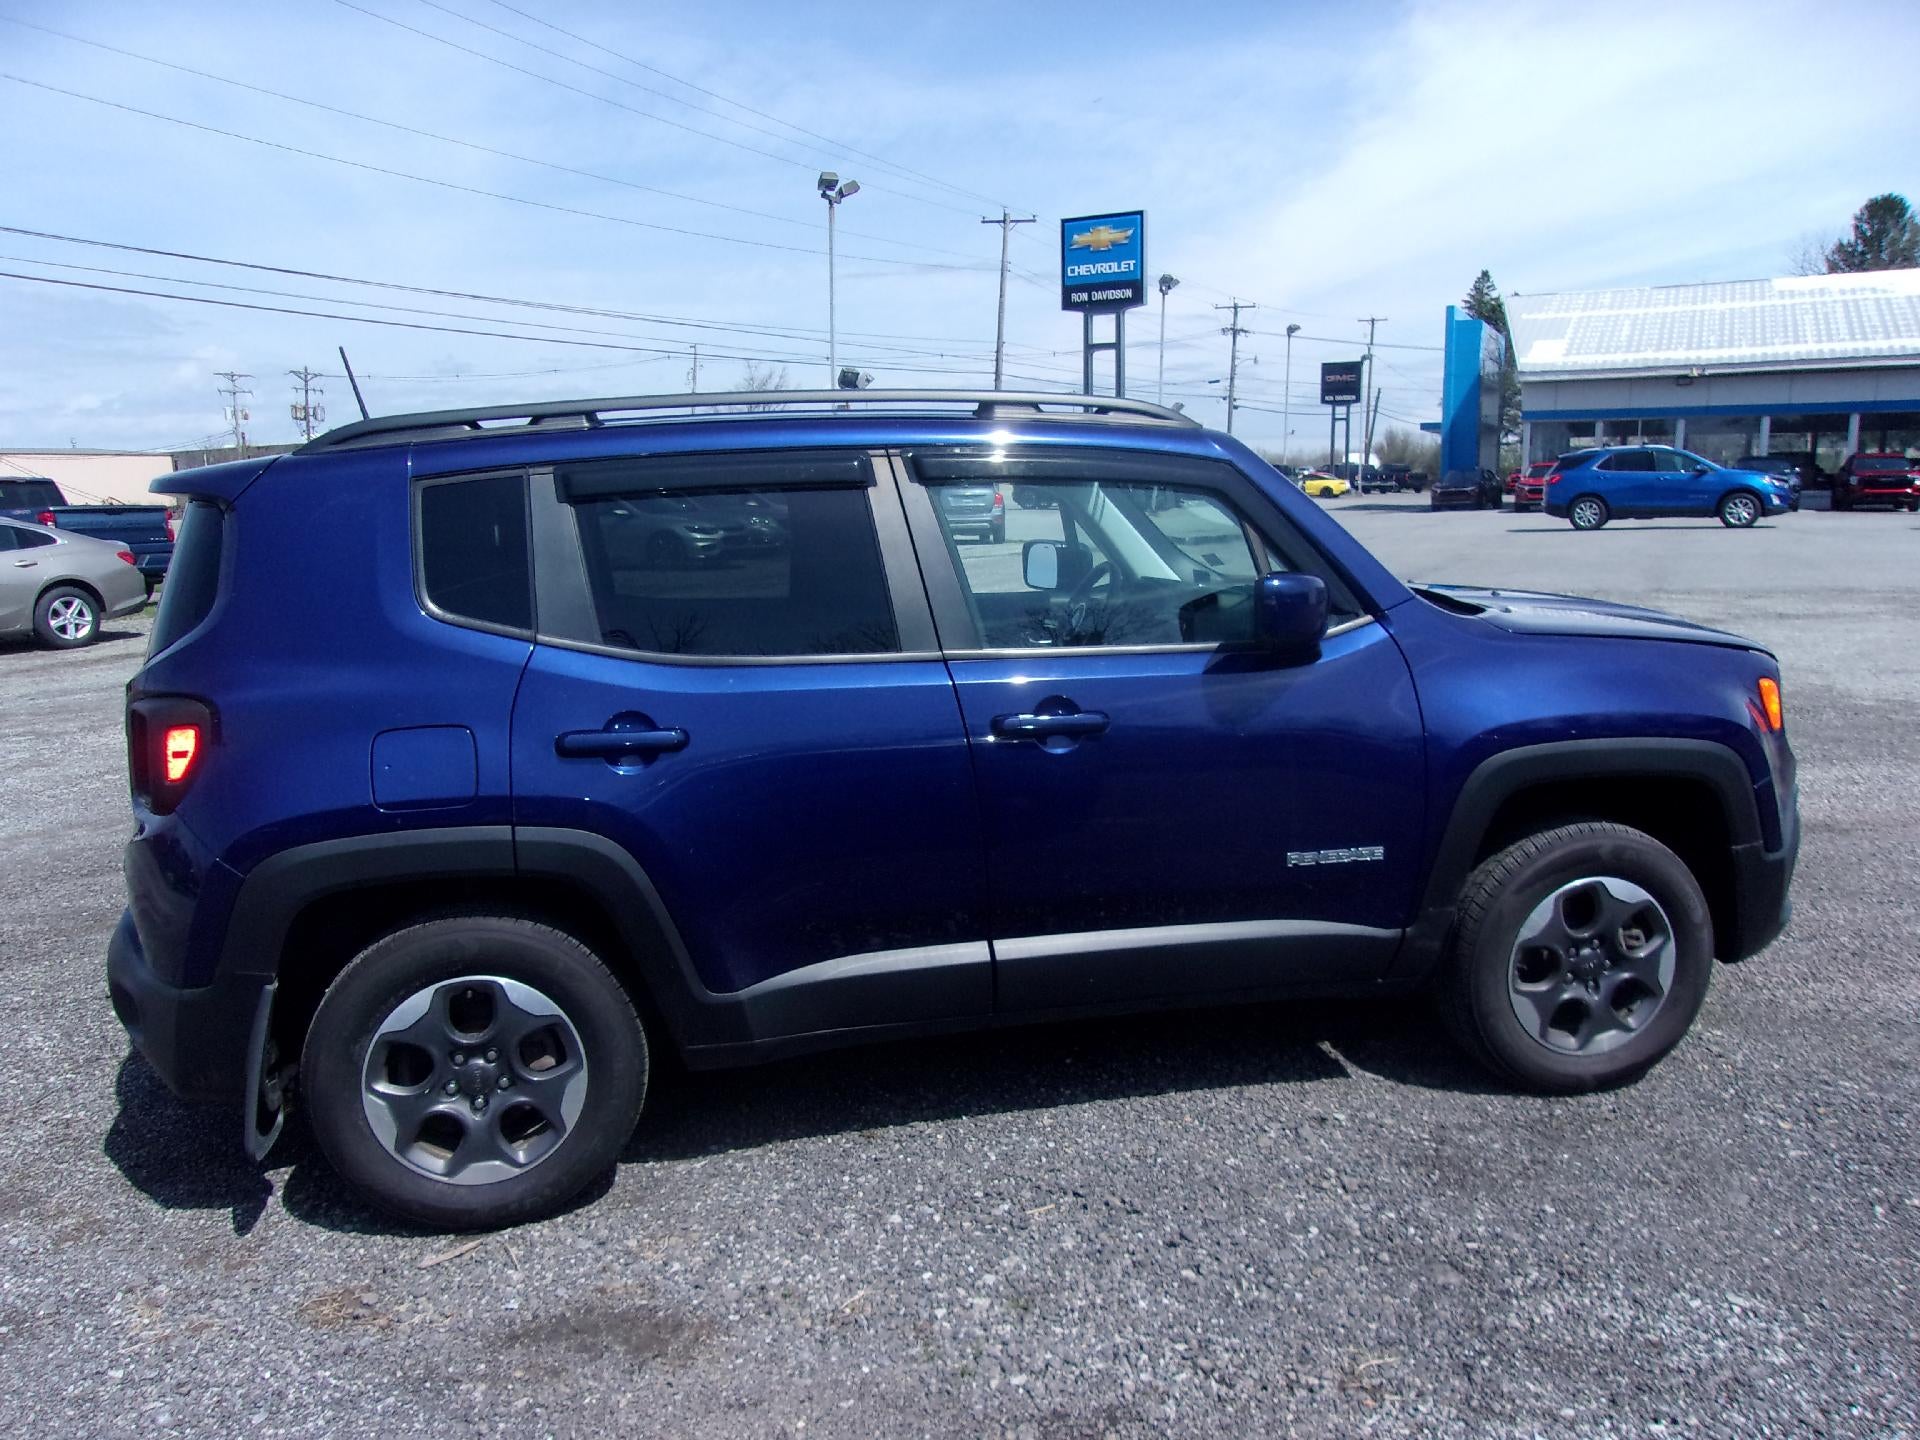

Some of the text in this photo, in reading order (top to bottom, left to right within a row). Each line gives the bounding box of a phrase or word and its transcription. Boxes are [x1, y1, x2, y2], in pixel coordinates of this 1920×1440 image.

[1067, 260, 1136, 276] CHEVROLET
[1071, 288, 1133, 303] RON DAVIDSON
[1287, 846, 1384, 867] RENEGADE
